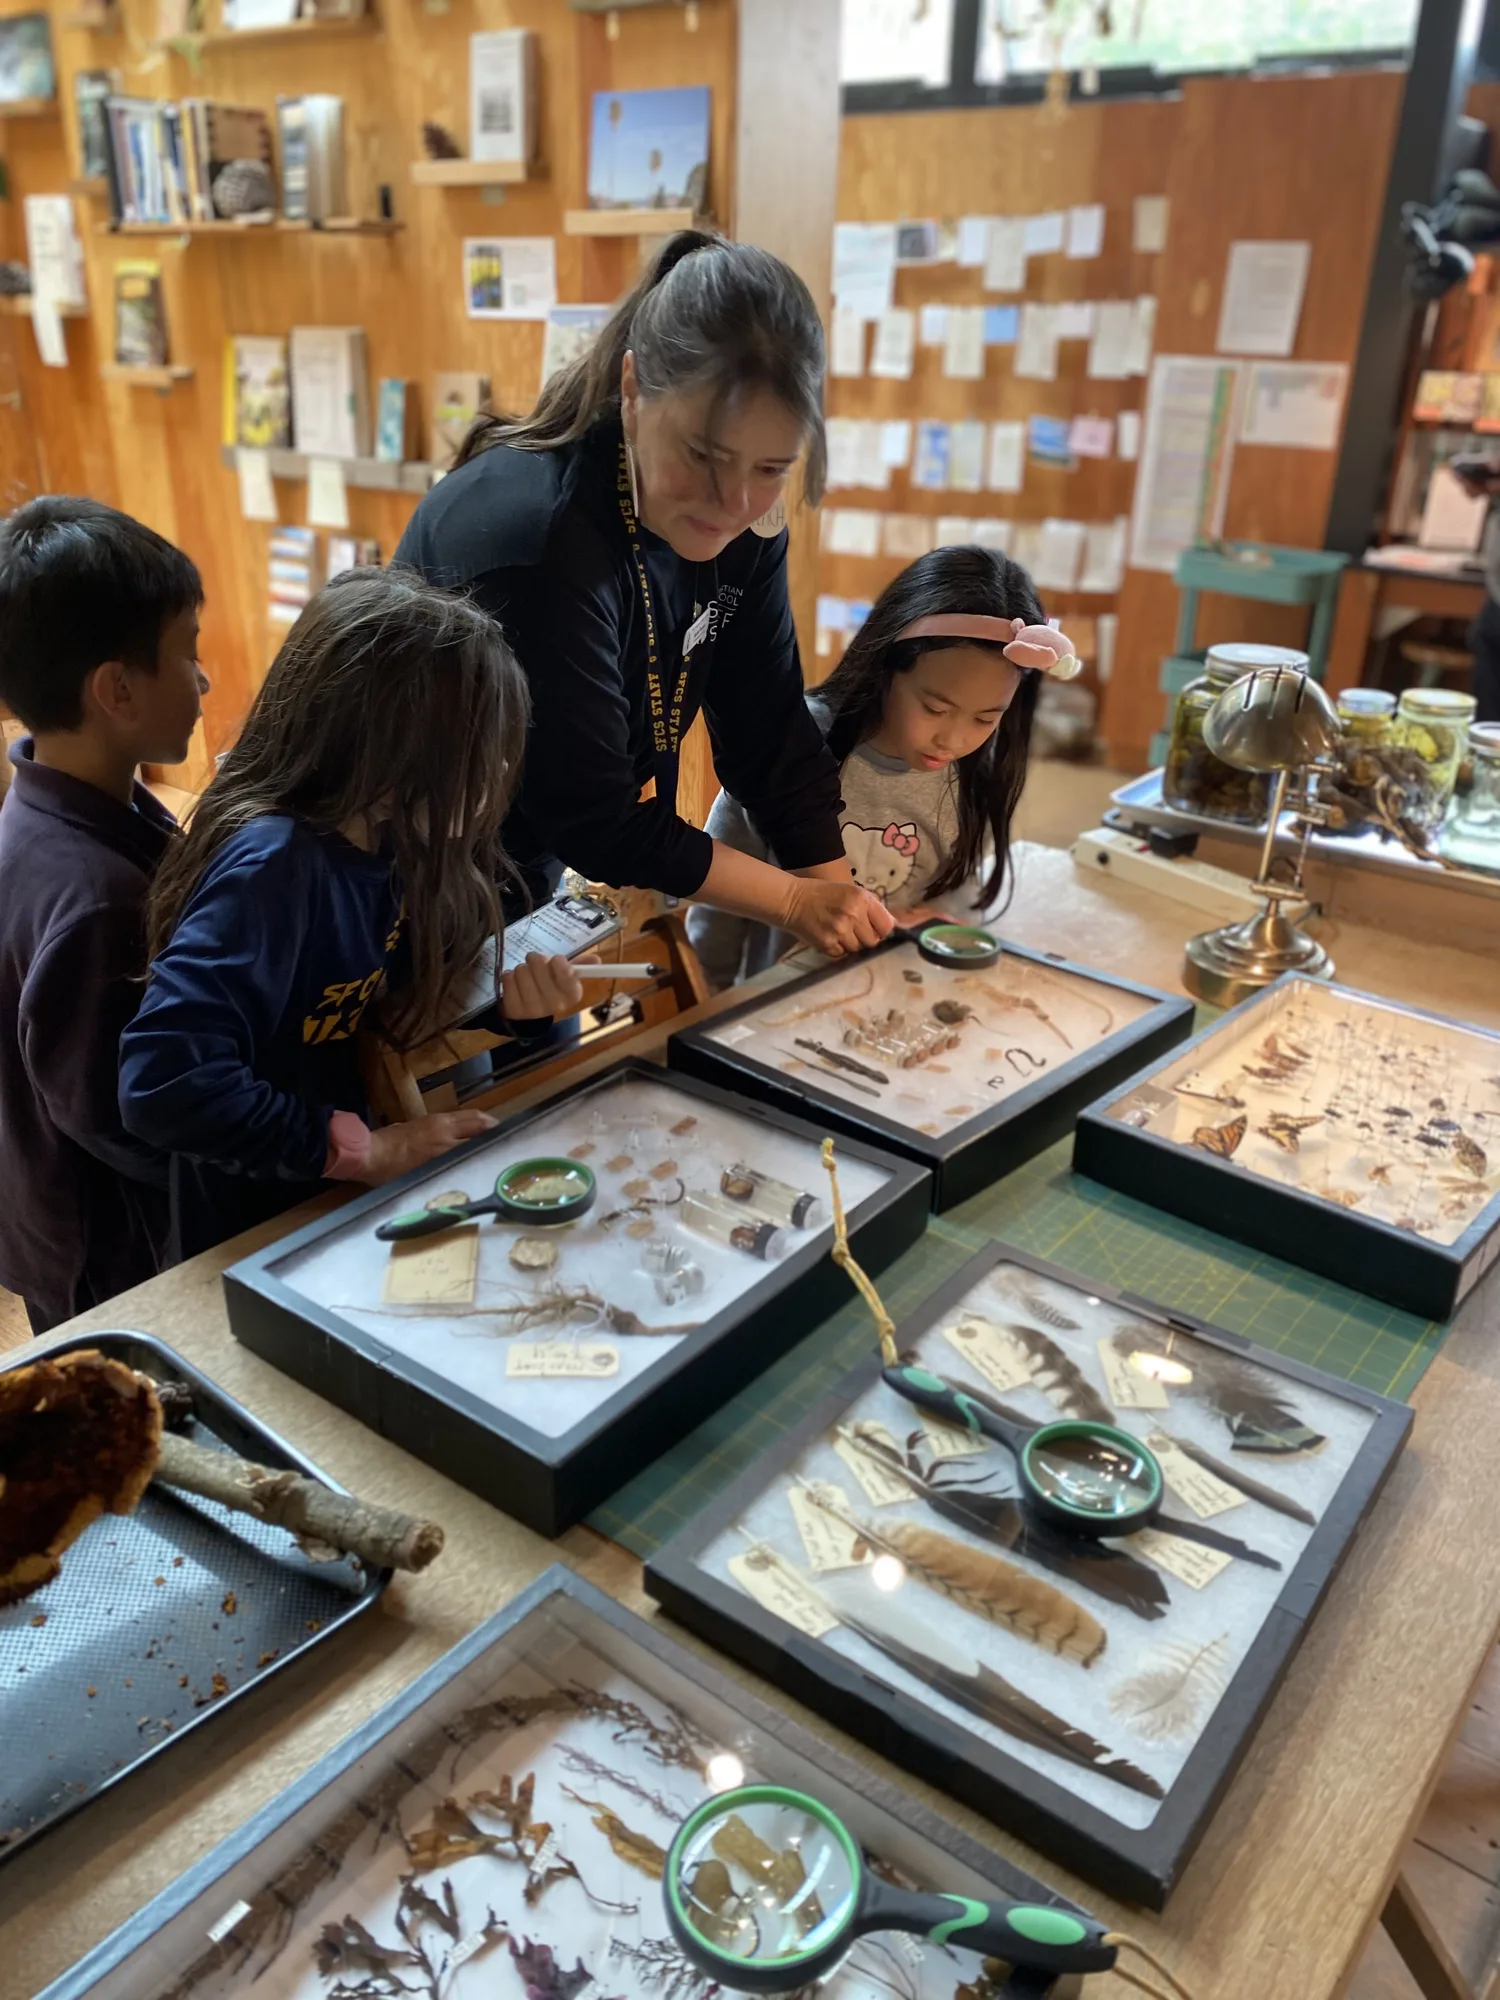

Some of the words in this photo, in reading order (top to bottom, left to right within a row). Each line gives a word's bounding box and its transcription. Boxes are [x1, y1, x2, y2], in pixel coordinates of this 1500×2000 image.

[647, 672, 663, 716] STAFF
[674, 671, 687, 702] SFCS
[653, 720, 667, 752] SFCS
